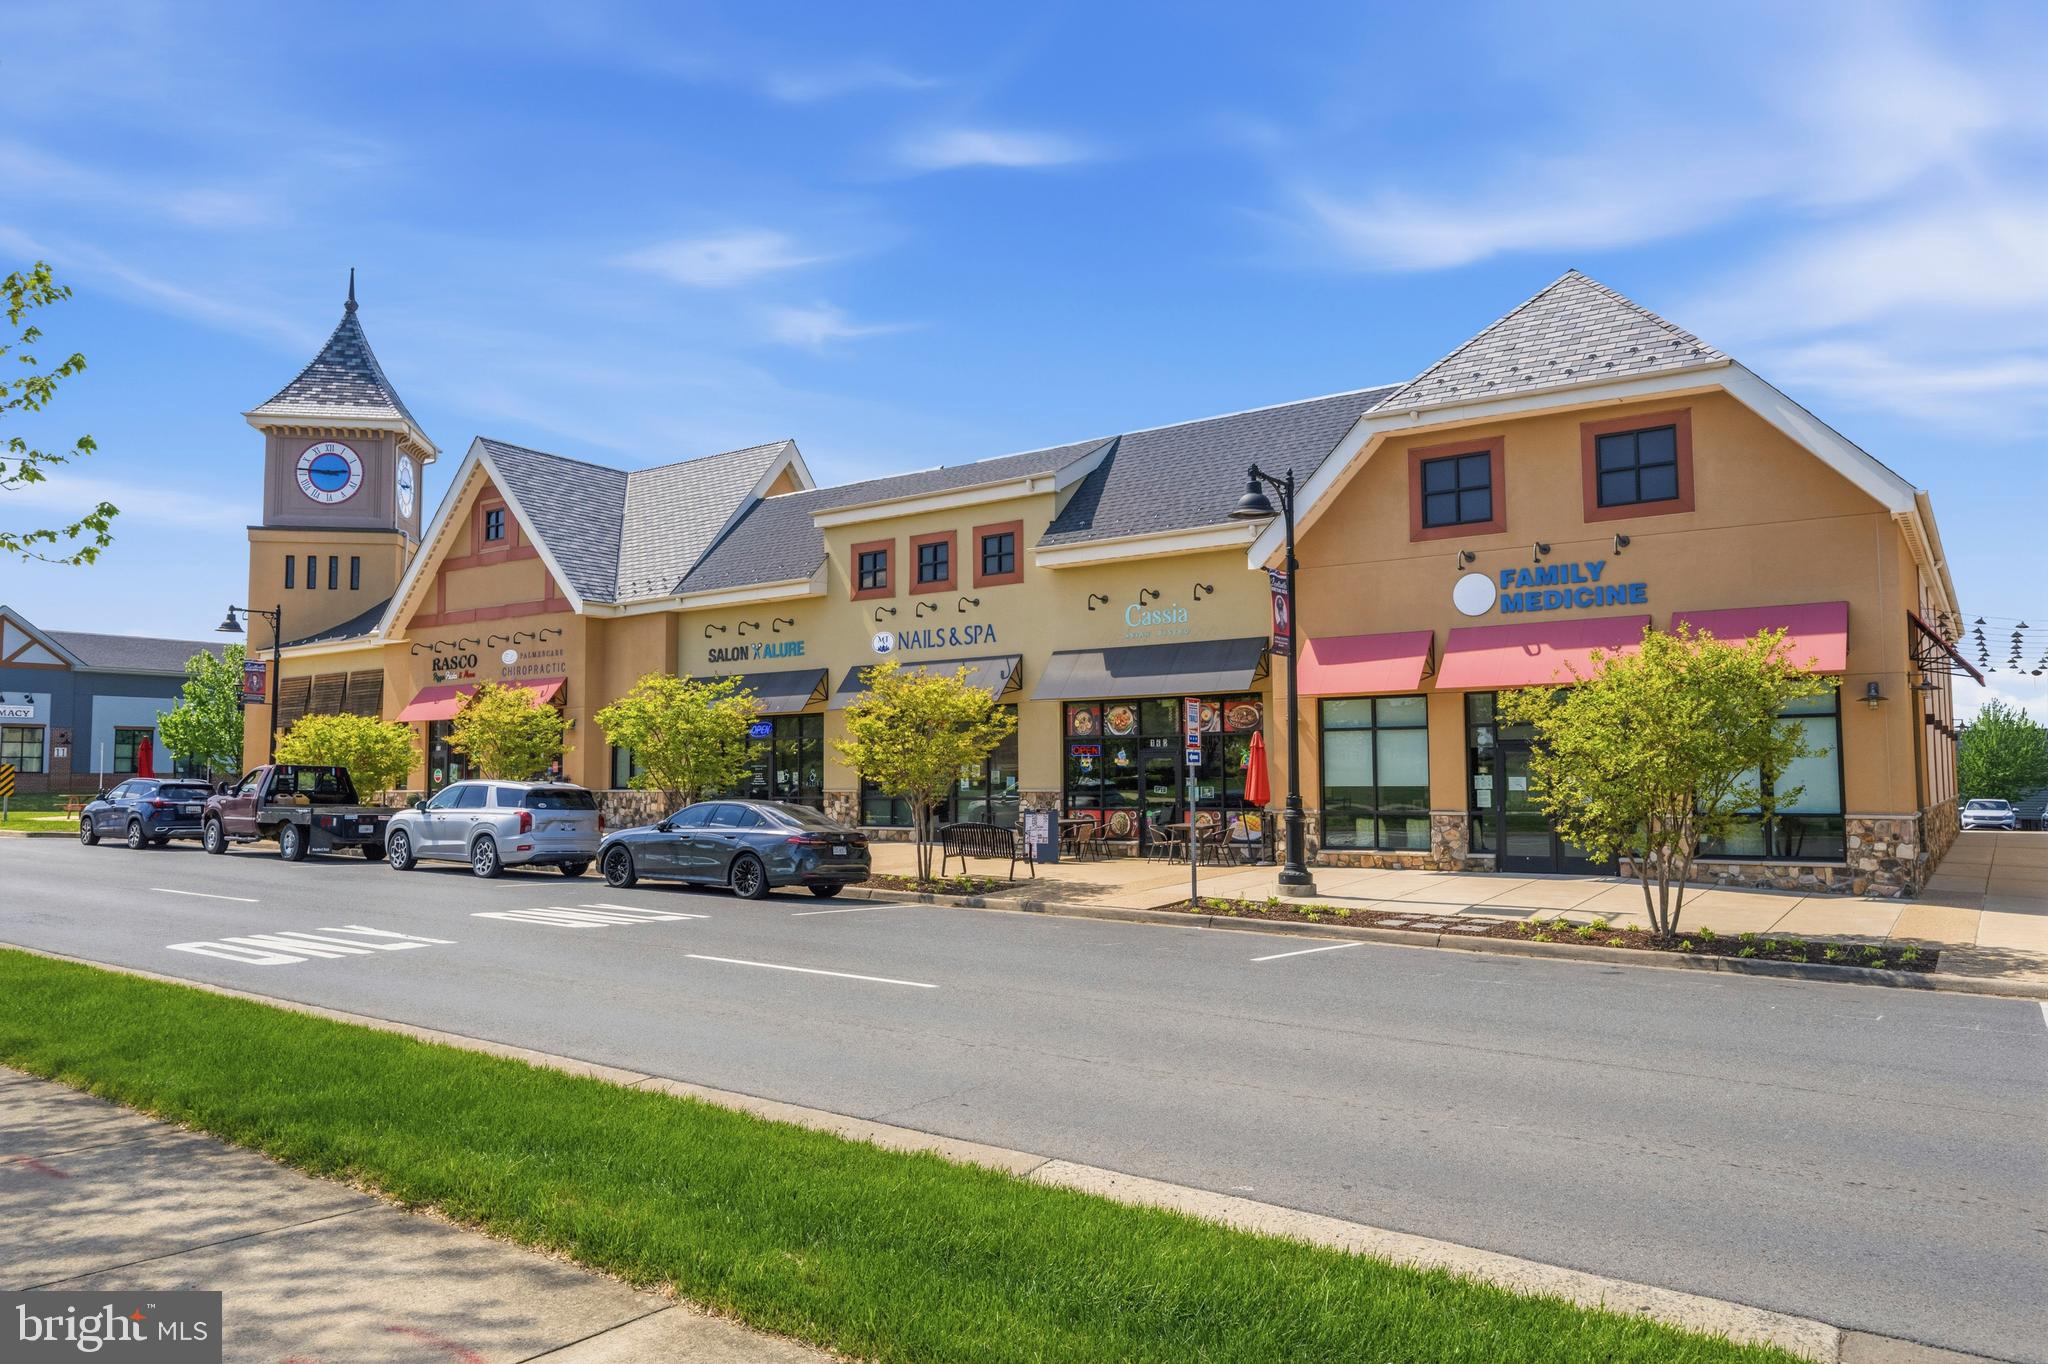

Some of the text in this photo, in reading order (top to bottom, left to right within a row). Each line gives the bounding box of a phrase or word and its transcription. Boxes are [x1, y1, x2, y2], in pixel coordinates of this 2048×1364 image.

[1500, 560, 1606, 589] FAMILY
[1500, 583, 1648, 614] MEDICINE
[1125, 602, 1189, 627] Cassia
[708, 640, 805, 663] SALON ALURE
[432, 654, 478, 671] RASCO
[502, 662, 566, 677] CHIROPRACTIC
[751, 725, 771, 735] OPEN
[1073, 746, 1098, 755] OPEN
